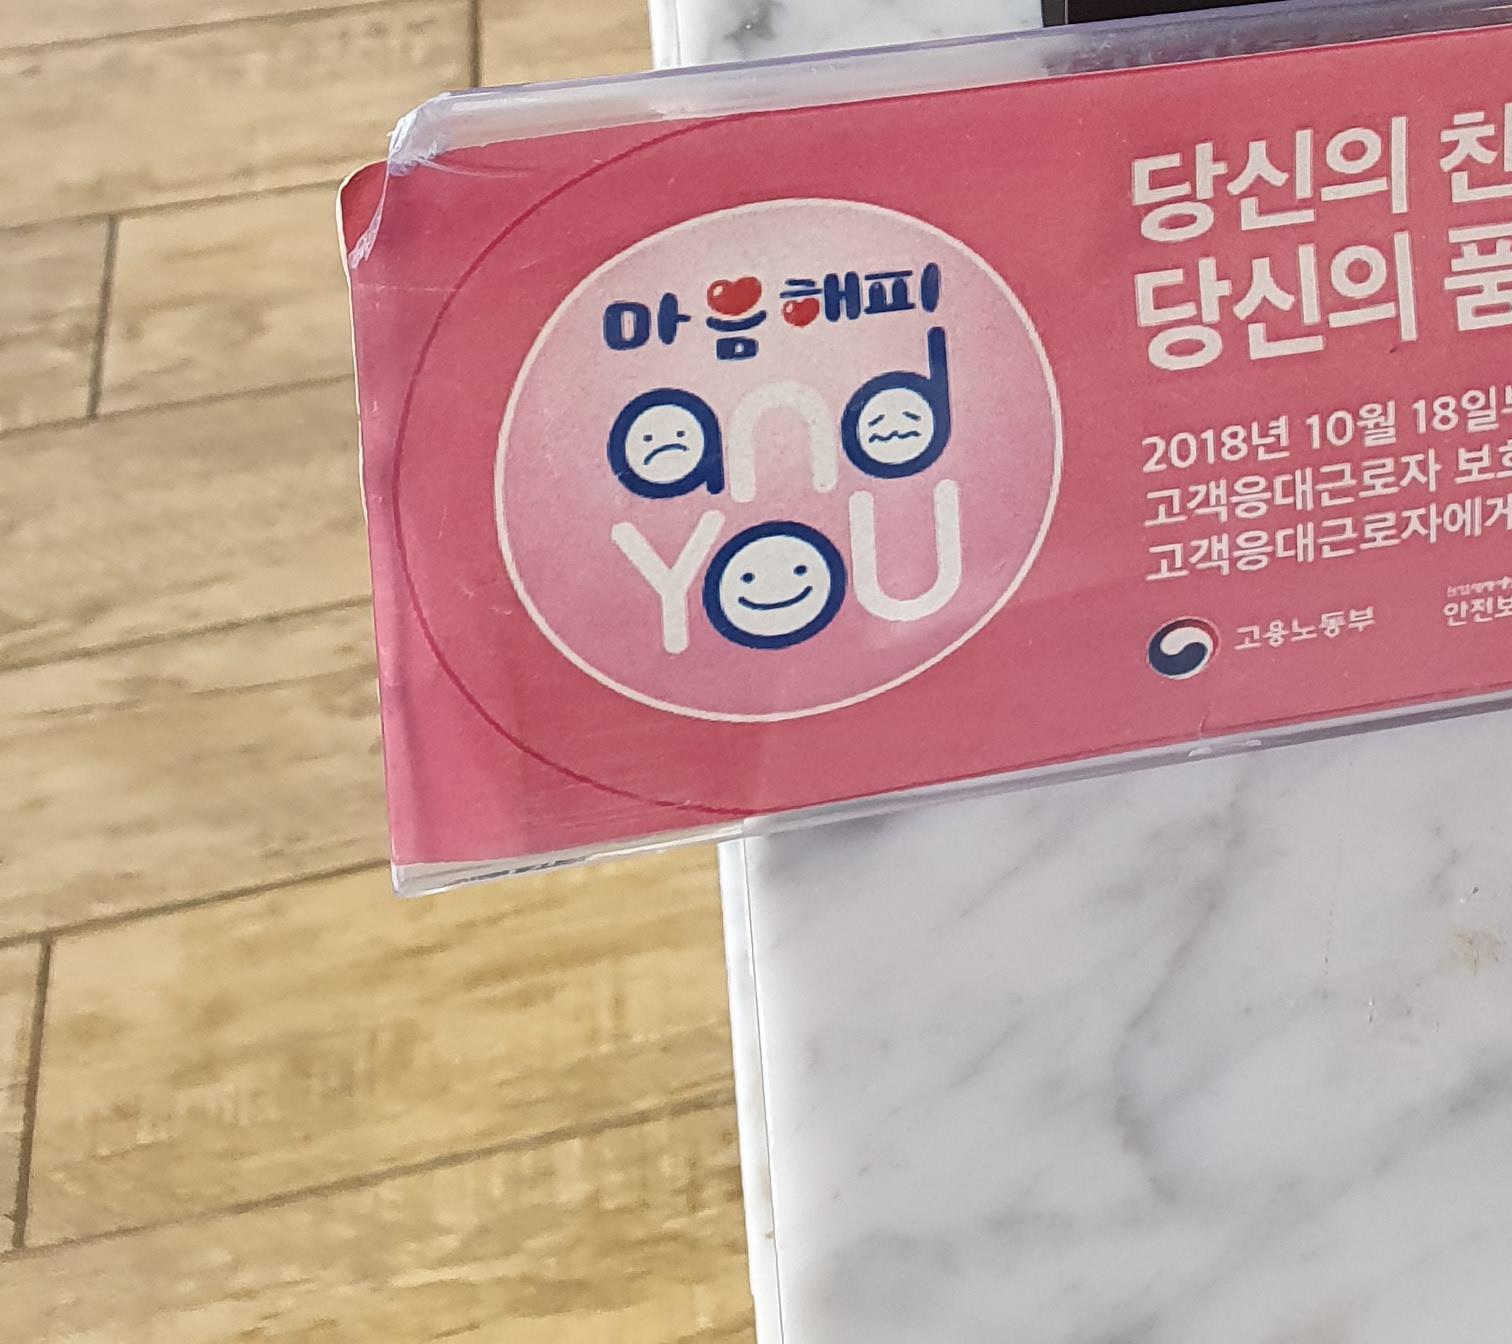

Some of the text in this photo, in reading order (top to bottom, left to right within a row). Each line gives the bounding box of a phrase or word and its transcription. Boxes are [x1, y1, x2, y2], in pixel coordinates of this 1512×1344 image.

[1131, 115, 1410, 244] 당신의
[1135, 229, 1418, 372] 당신의
[606, 326, 951, 502] and
[1141, 415, 1290, 473] 2018년
[1305, 401, 1397, 450] 10월
[1143, 448, 1441, 527] 고객응대근로자
[611, 479, 962, 655] YOU
[1234, 605, 1376, 651] 고용노동부
